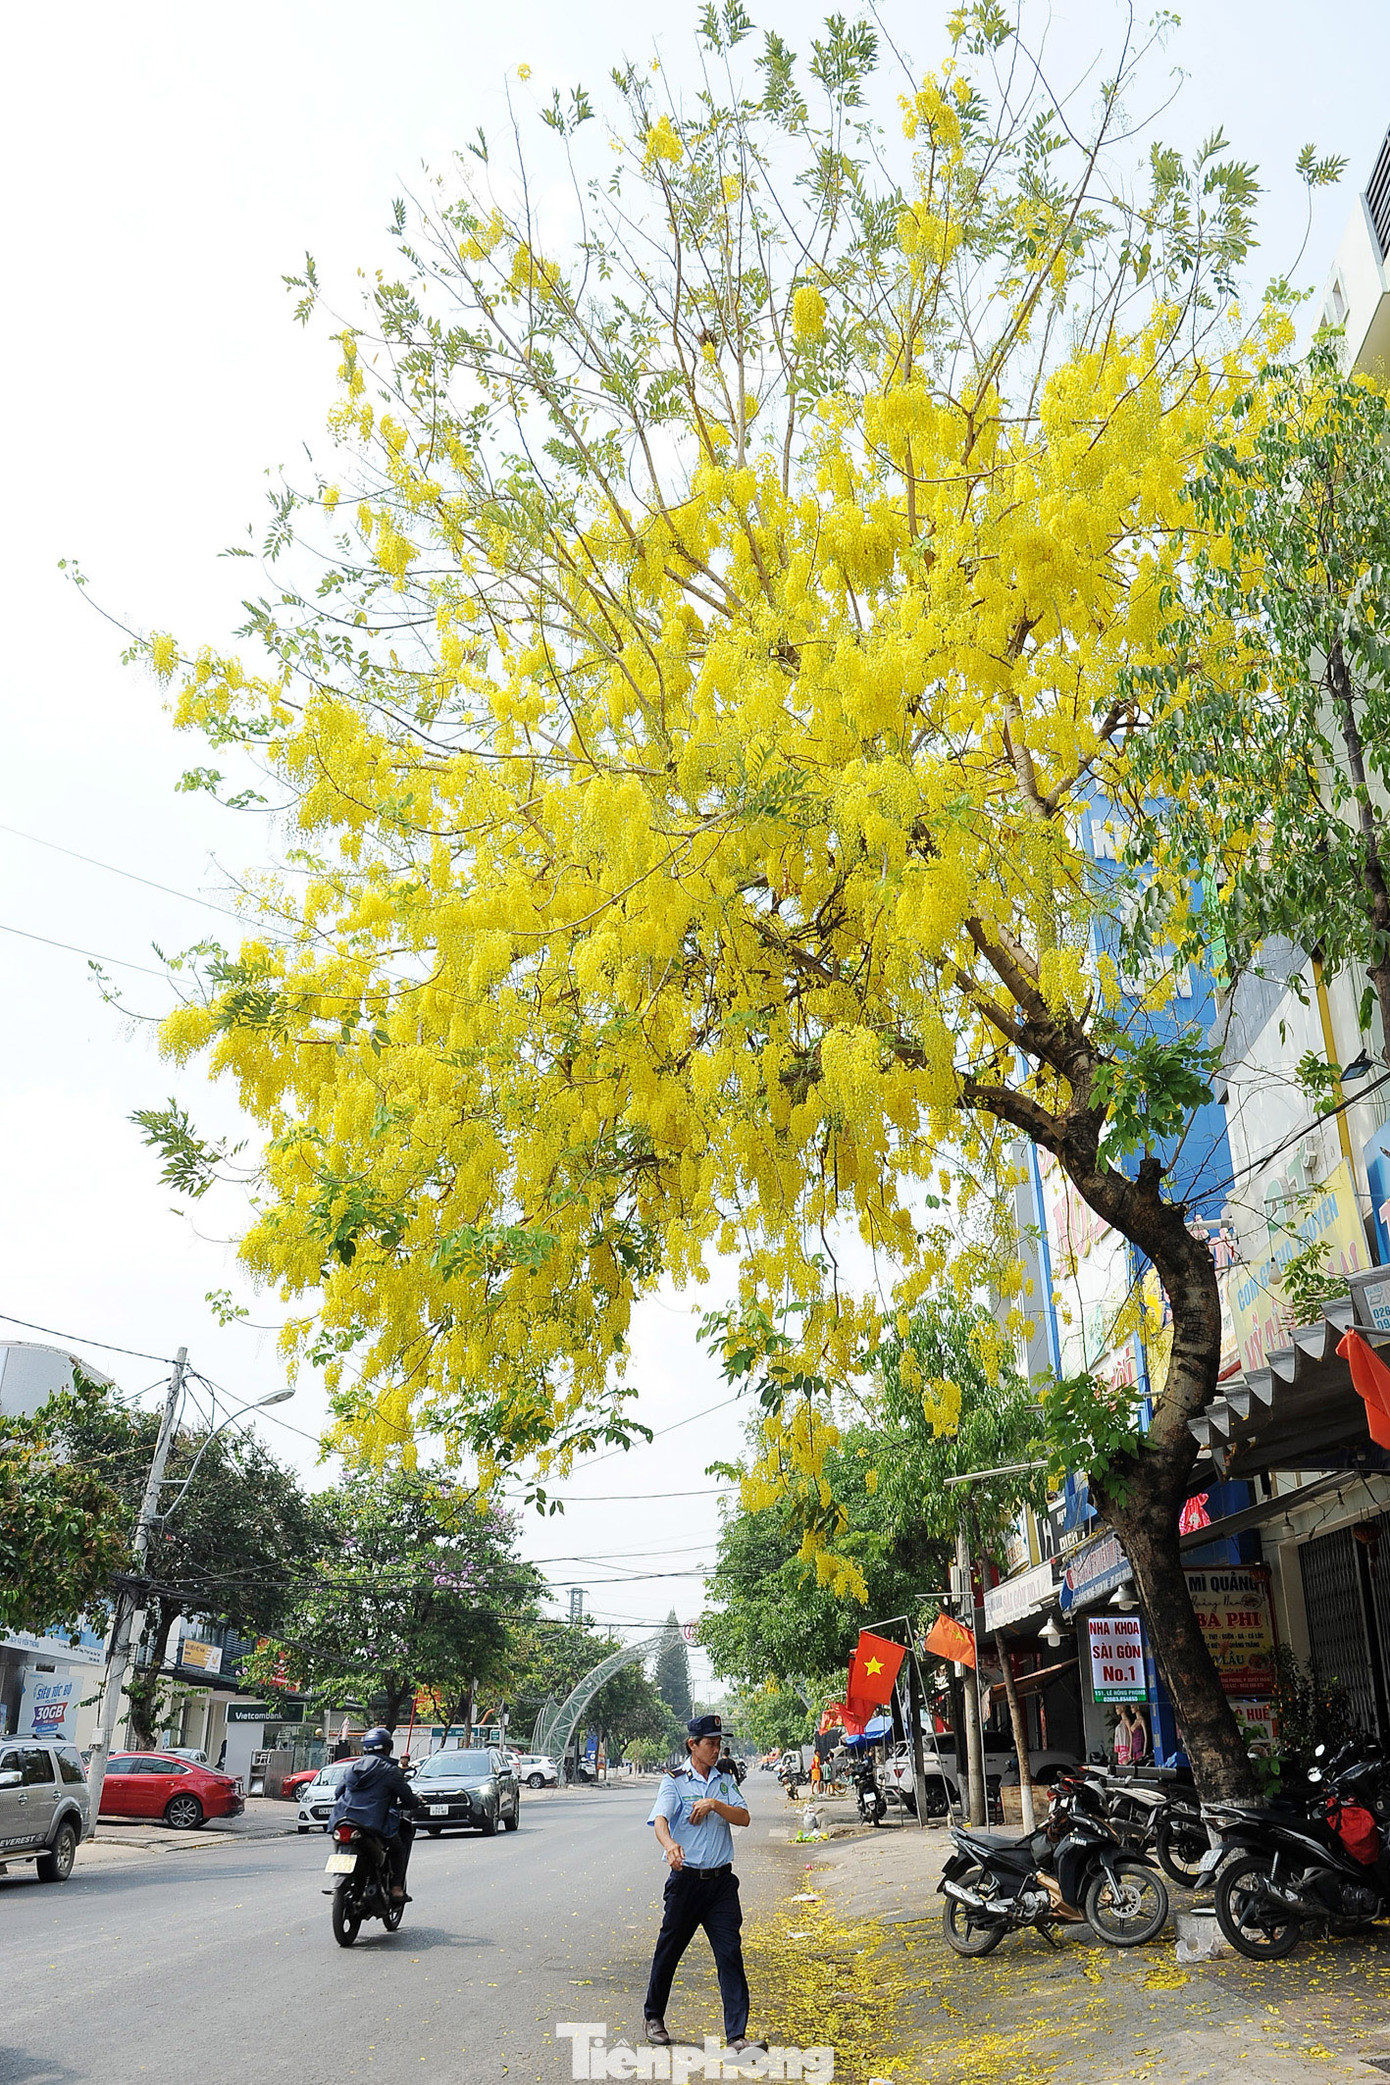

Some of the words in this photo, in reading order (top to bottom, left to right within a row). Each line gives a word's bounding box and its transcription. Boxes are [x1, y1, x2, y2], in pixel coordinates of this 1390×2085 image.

[1188, 1574, 1206, 1592] MÌ
[1211, 1571, 1258, 1593] QUẢNG
[1226, 1611, 1262, 1628] PHI
[1090, 1622, 1110, 1635] NHA
[1114, 1621, 1139, 1635] KHOA
[1092, 1642, 1113, 1659] SÀI
[1116, 1641, 1141, 1658] GÒN
[1103, 1665, 1136, 1681] No.1
[36, 1705, 64, 1721] 30GB
[235, 1711, 283, 1720] Vietcombank
[0, 1835, 36, 1847] EVEREST
